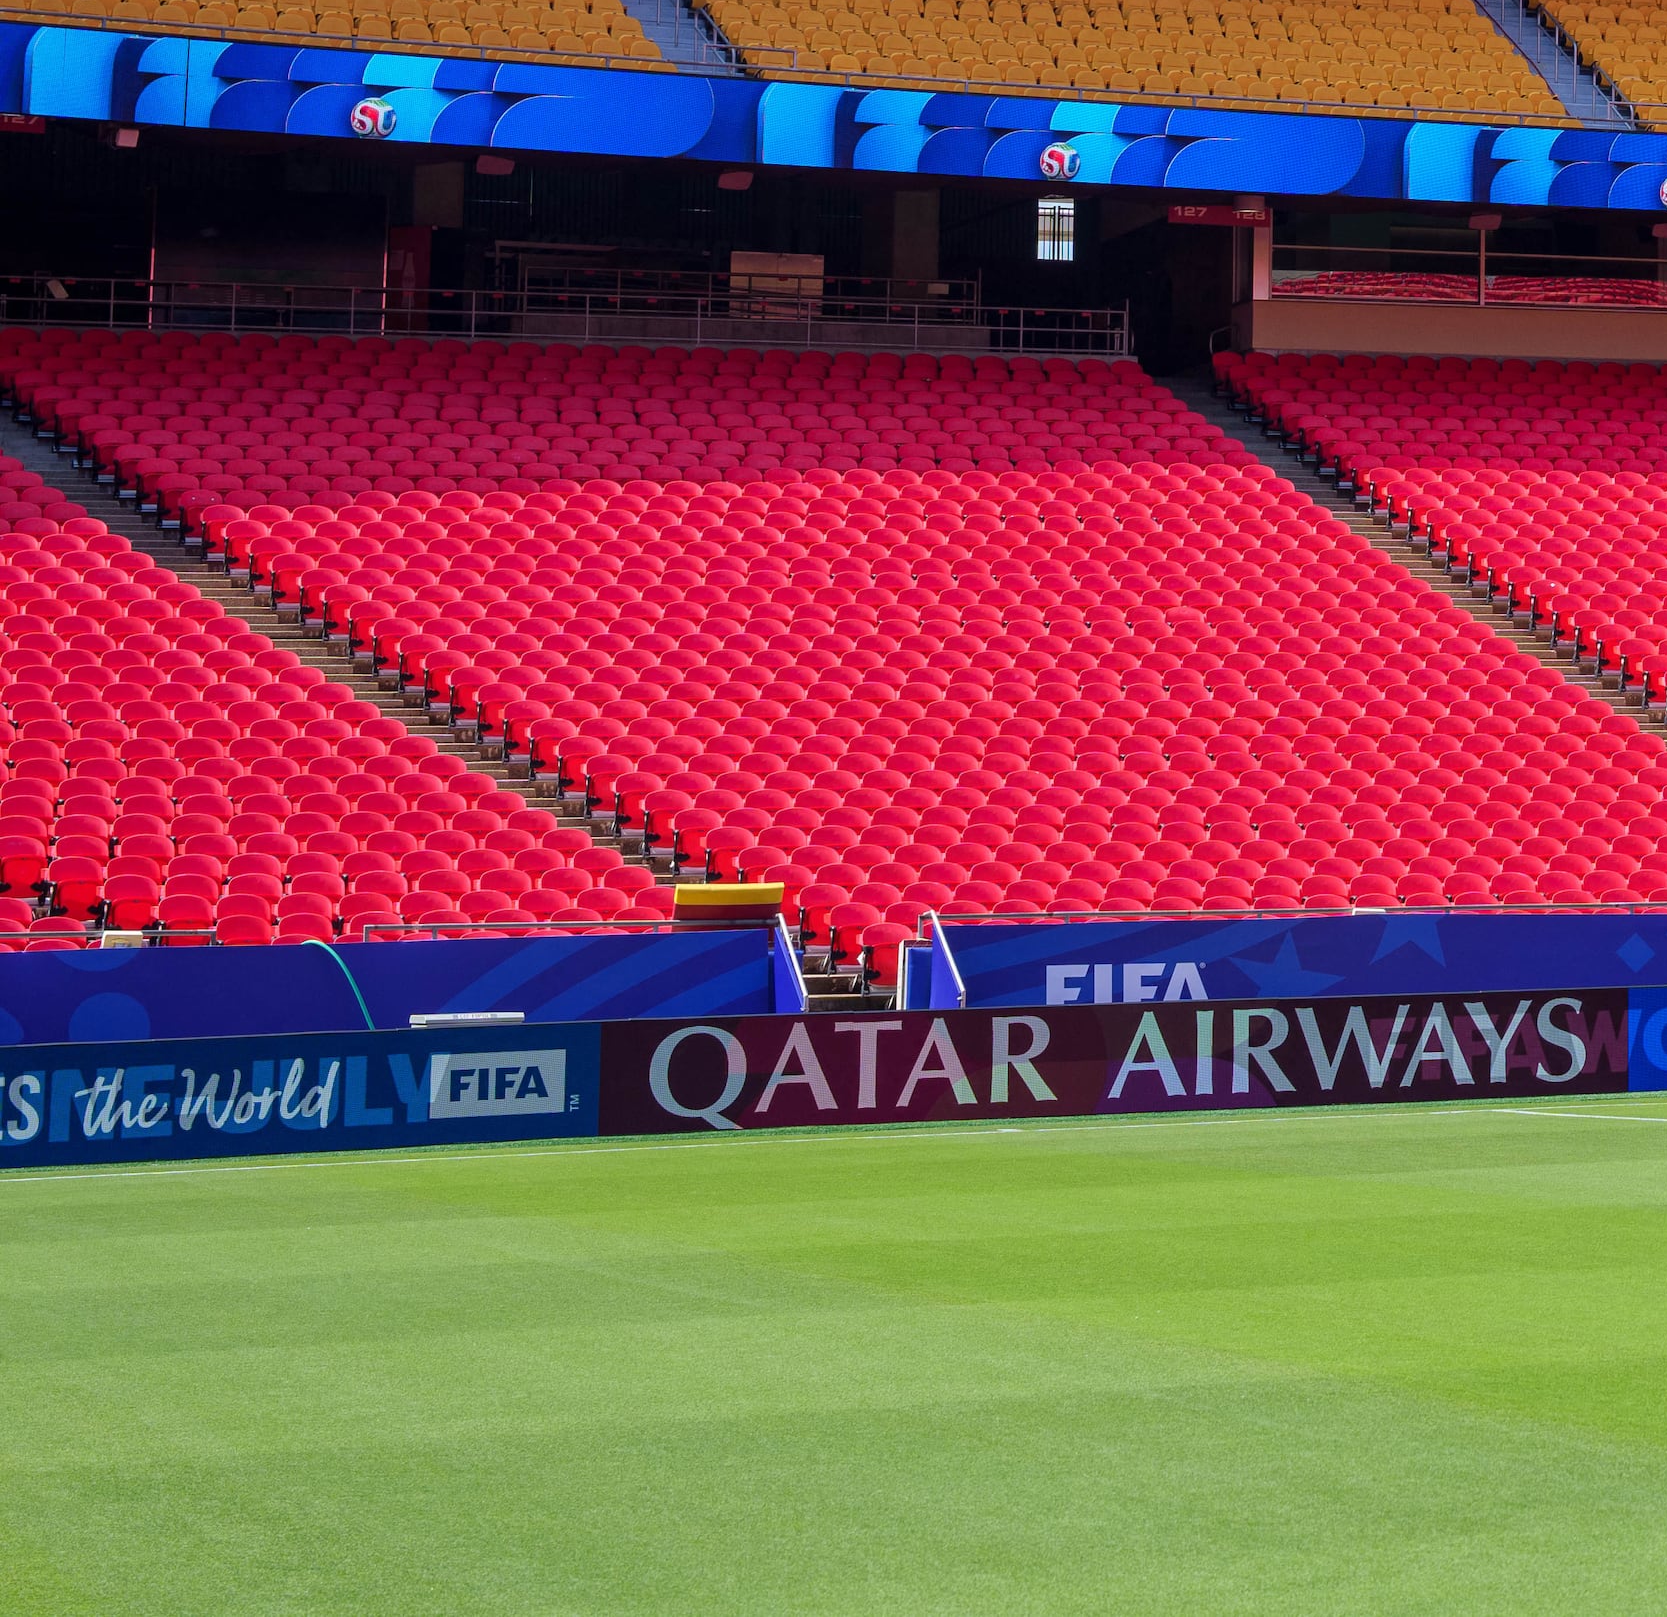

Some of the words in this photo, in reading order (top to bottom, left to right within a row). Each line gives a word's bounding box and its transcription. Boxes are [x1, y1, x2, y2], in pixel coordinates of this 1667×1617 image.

[1173, 205, 1208, 218] 127
[1046, 962, 1208, 1005] FIFA
[450, 1065, 549, 1102] FIFA
[648, 1015, 1059, 1130] QATAR
[1107, 996, 1587, 1101] AIRWAYS
[75, 1068, 168, 1137] the
[179, 1057, 341, 1132] World
